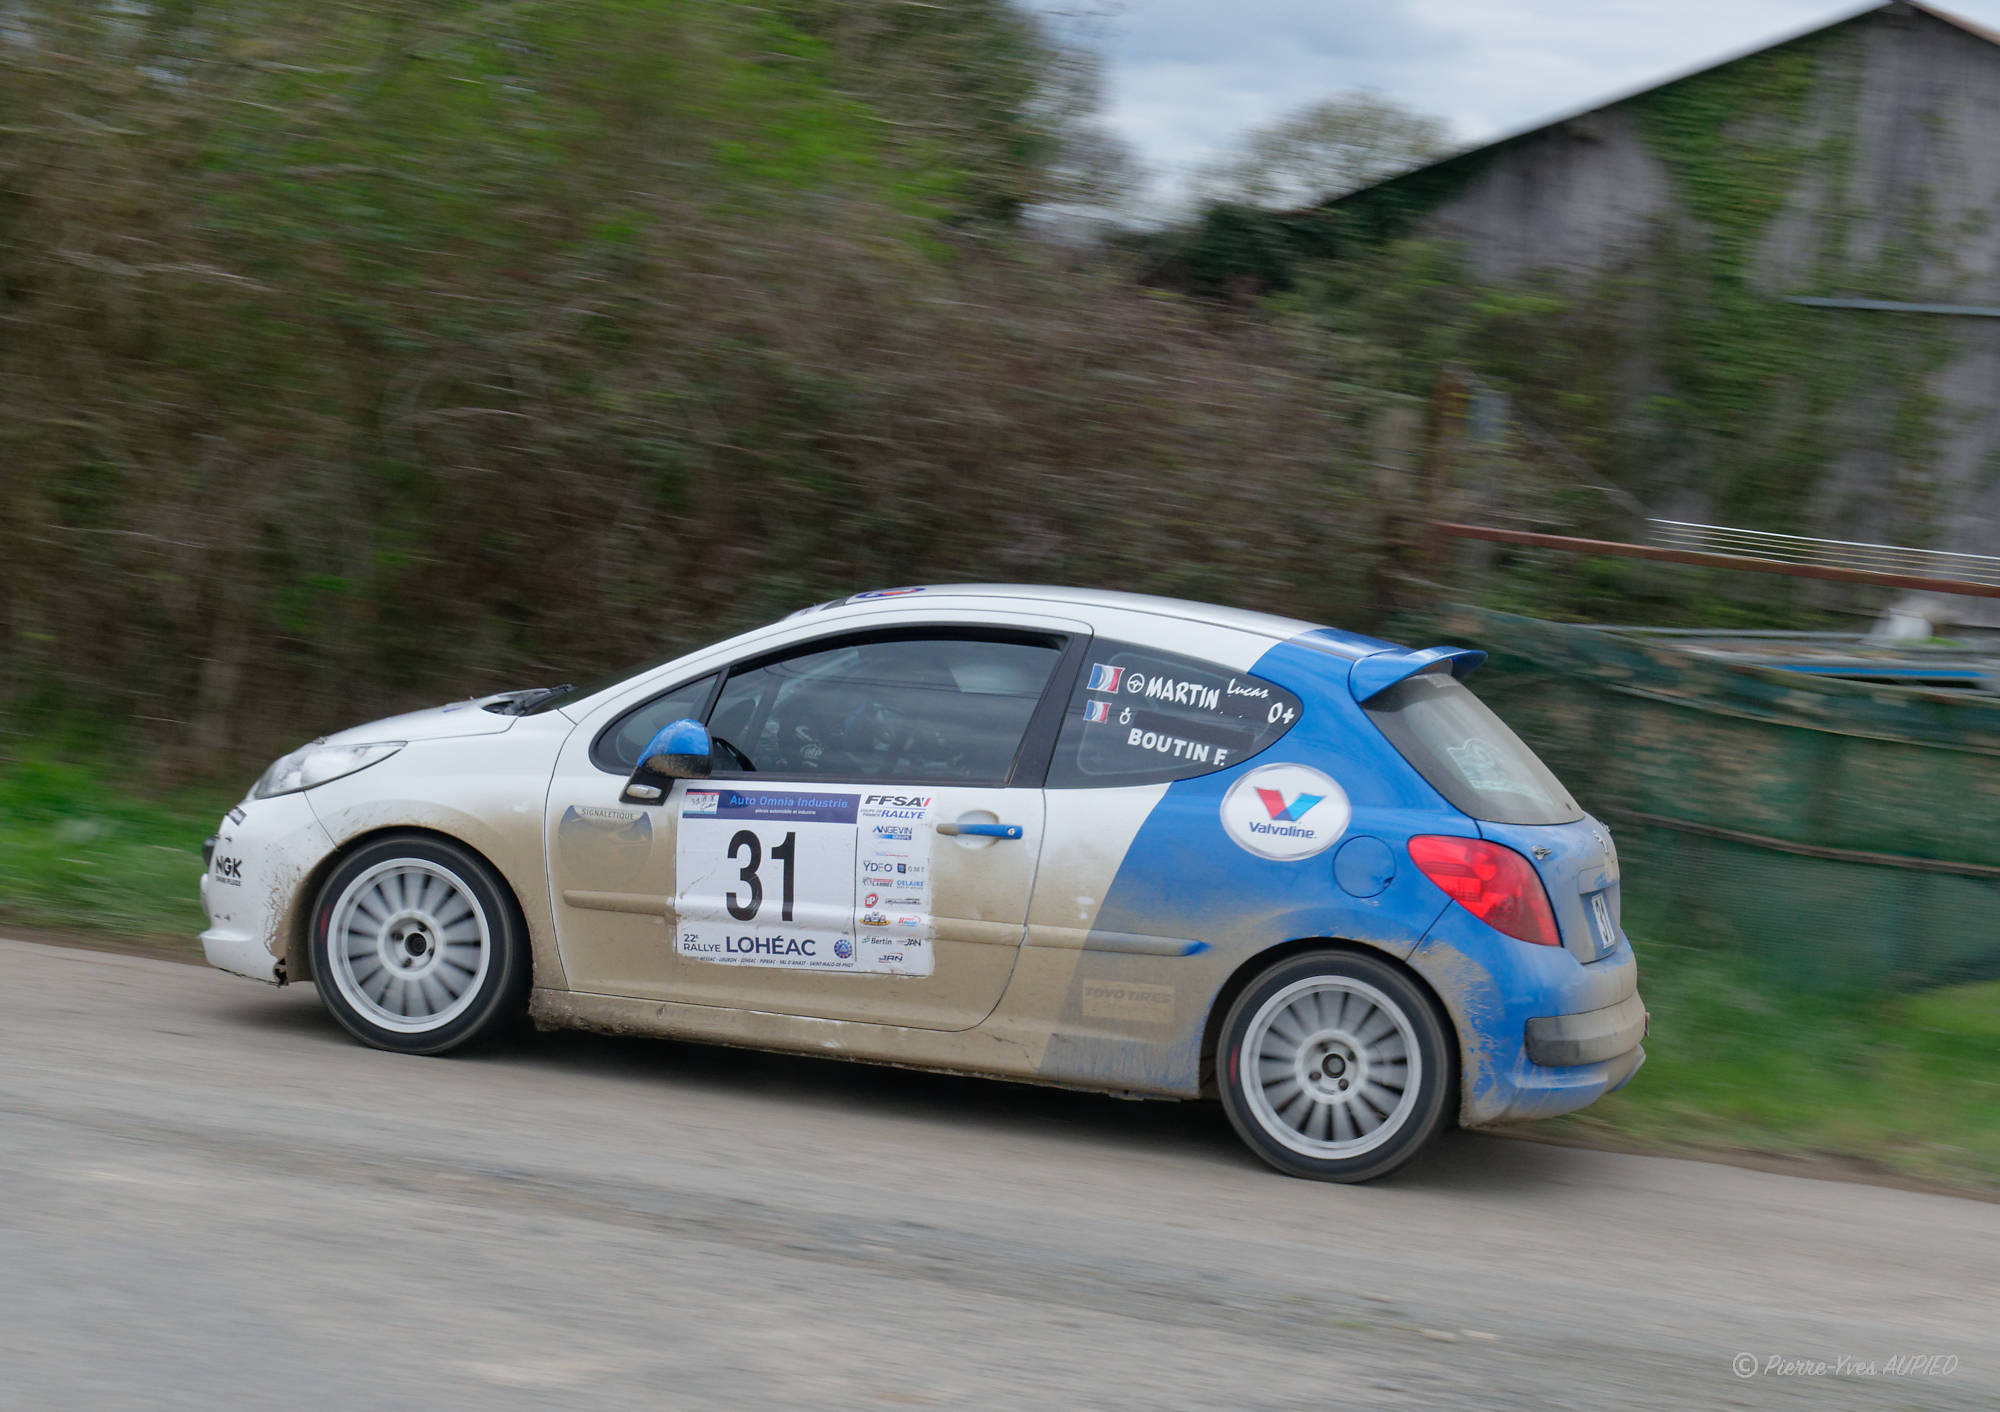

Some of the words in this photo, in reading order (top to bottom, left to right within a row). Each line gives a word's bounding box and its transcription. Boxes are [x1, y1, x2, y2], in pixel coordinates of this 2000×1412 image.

[1145, 676, 1220, 710] MARTIN
[1226, 678, 1269, 699] Lucas
[1127, 728, 1210, 762] BOUTIN
[1213, 748, 1228, 766] F.
[729, 795, 757, 805] Auto
[759, 796, 794, 807] Omnia
[797, 796, 849, 809] Industrie
[865, 795, 922, 807] FFSA
[881, 809, 925, 819] RALLYE
[872, 825, 913, 834] ANGEVIN
[1248, 821, 1315, 839] Valvoline
[215, 856, 242, 878] NGK
[726, 829, 796, 922] 31
[683, 943, 721, 952] RALLYE
[726, 935, 816, 957] LOHÉAC
[871, 937, 892, 945] Bertin
